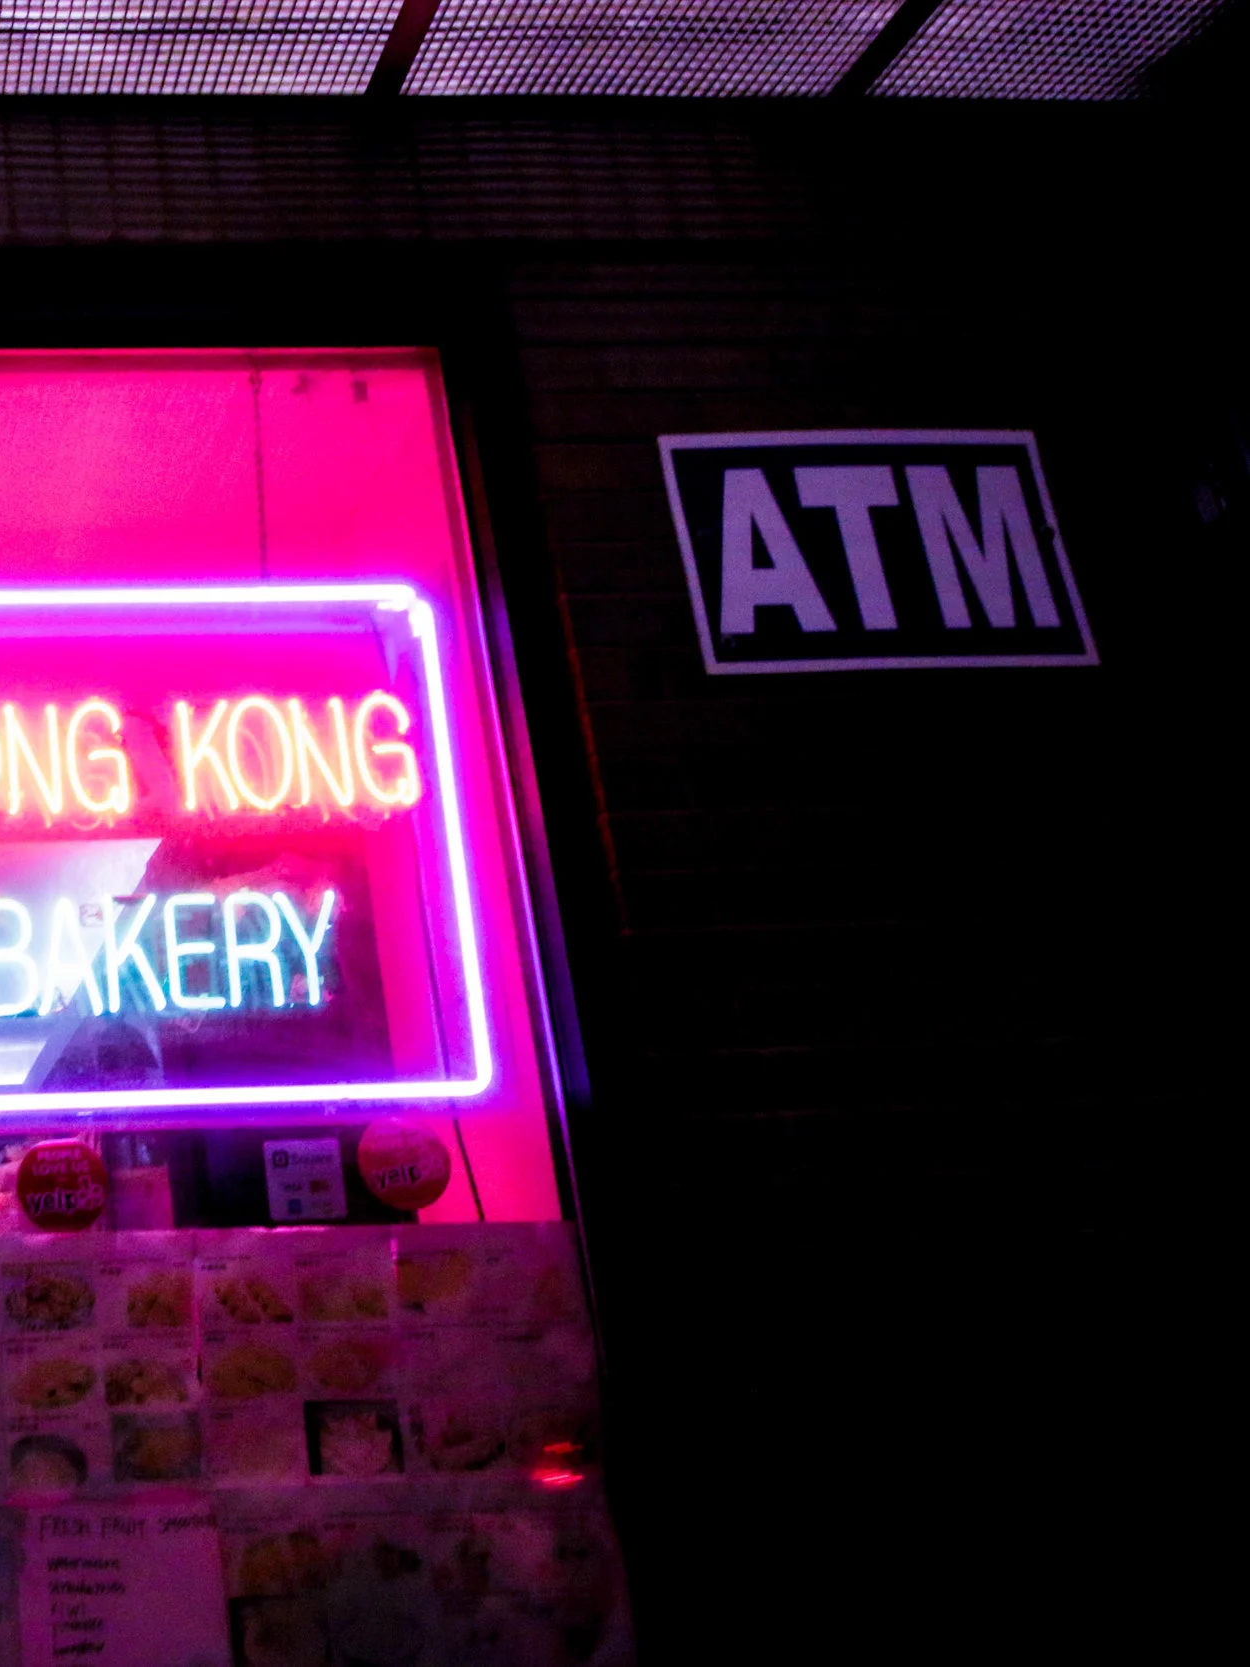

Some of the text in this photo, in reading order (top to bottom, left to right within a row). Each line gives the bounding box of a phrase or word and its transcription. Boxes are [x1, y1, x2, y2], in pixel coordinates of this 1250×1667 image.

[720, 465, 1061, 634] ATM
[174, 690, 421, 812] KONG
[31, 1159, 90, 1176] LOVE US
[36, 1148, 82, 1161] PEOPLE
[375, 1163, 423, 1190] yelp
[26, 1187, 79, 1217] yelp
